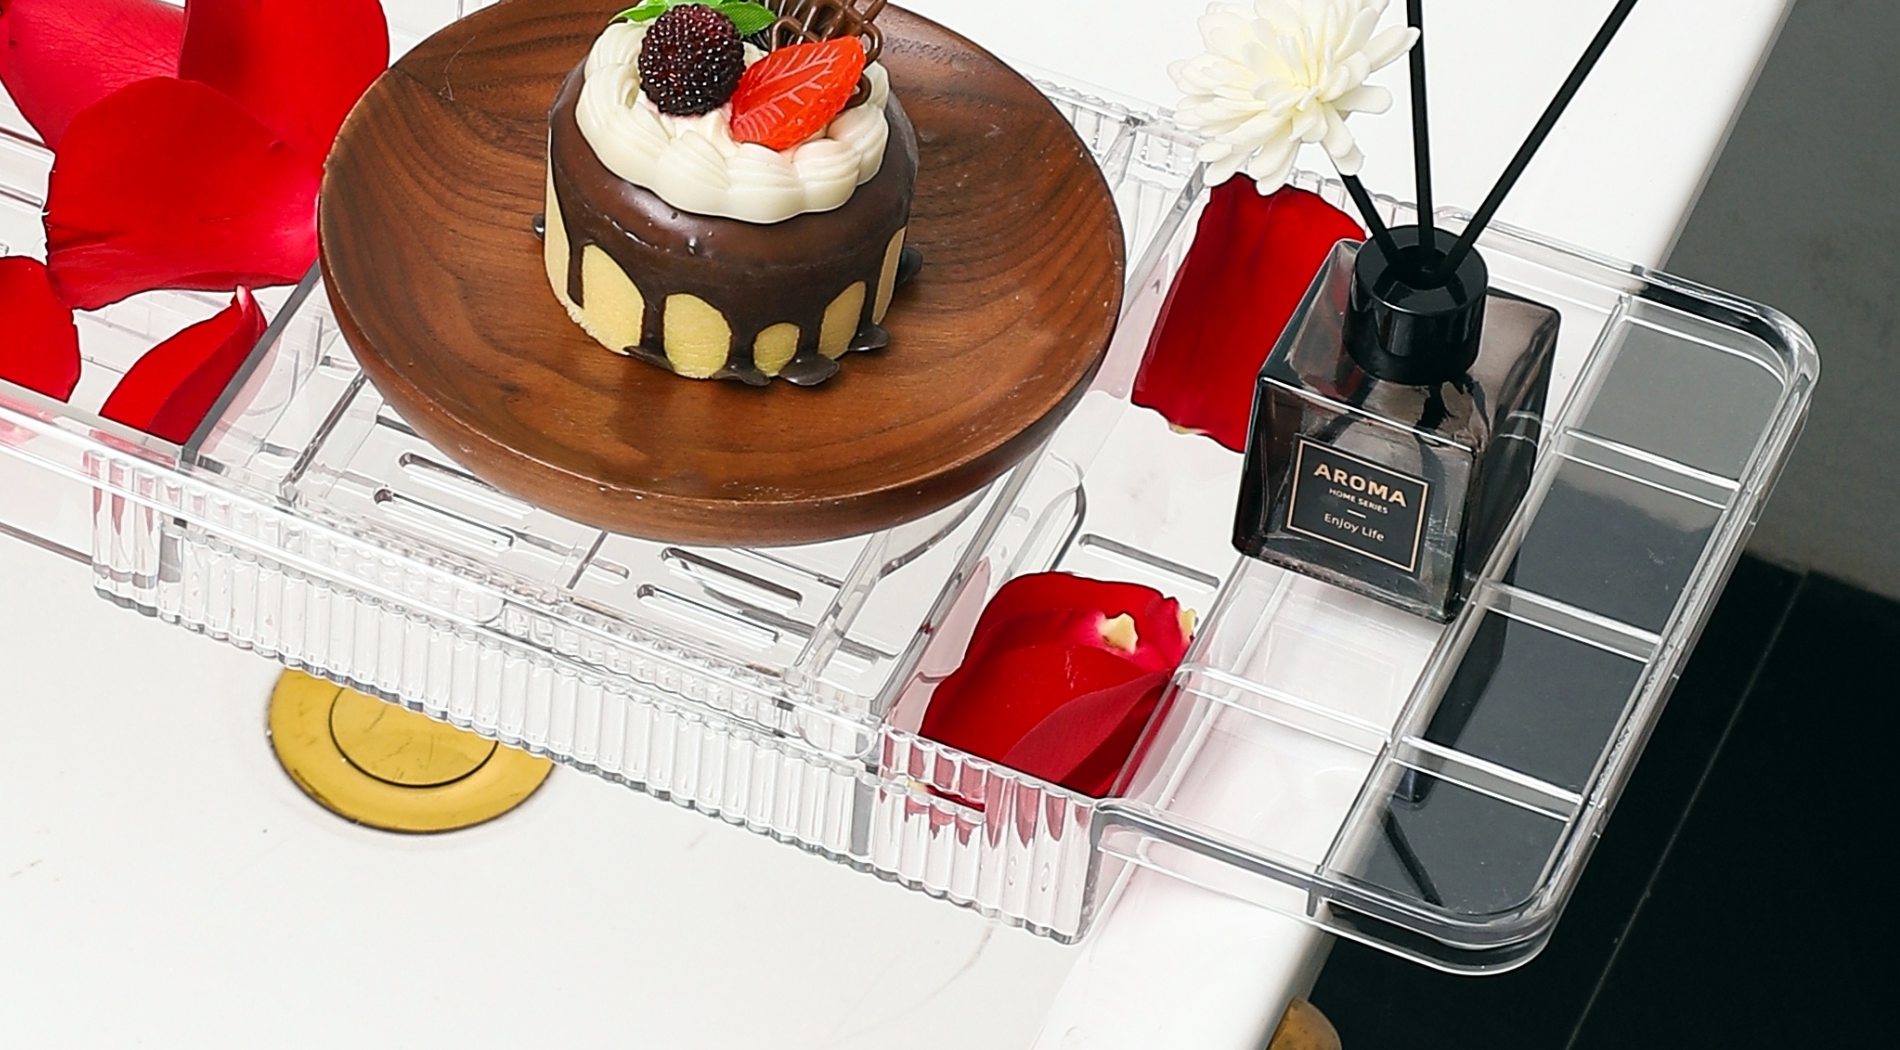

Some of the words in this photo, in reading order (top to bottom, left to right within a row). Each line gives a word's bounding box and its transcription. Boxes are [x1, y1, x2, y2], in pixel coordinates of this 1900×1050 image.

[1313, 463, 1407, 508] AROMA
[1329, 487, 1356, 503] HOME
[1357, 497, 1388, 514] SERIES
[1324, 512, 1359, 534] Enjoy
[1361, 526, 1385, 542] Life
